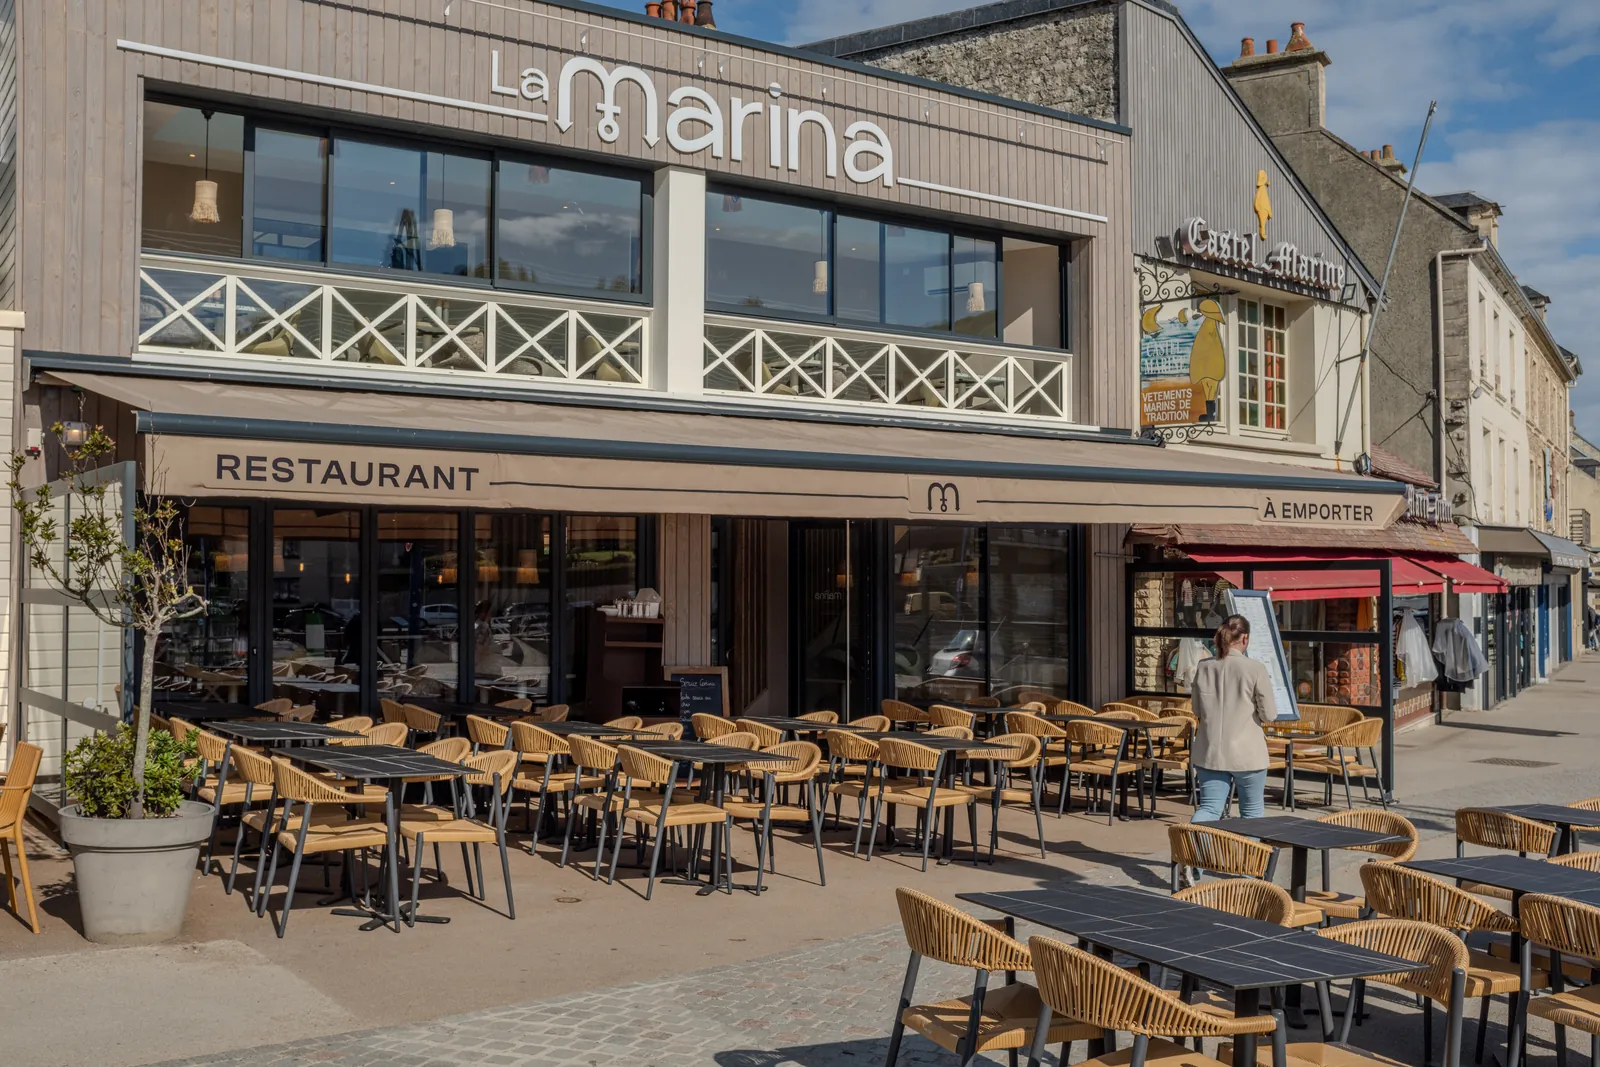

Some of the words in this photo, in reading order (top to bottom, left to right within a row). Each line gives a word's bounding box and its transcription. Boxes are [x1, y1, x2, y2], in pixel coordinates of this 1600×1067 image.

[491, 50, 549, 102] La
[554, 56, 894, 188] Marina
[1187, 216, 1257, 267] Castel
[1266, 242, 1346, 289] Marine
[1142, 388, 1193, 402] VETEMENTS
[1143, 400, 1176, 413] MARINS
[1179, 399, 1191, 410] DE
[1145, 410, 1190, 422] TRADITION
[216, 453, 480, 492] RESTAURANT
[1264, 496, 1277, 519] À
[1282, 502, 1373, 522] EMPORTER
